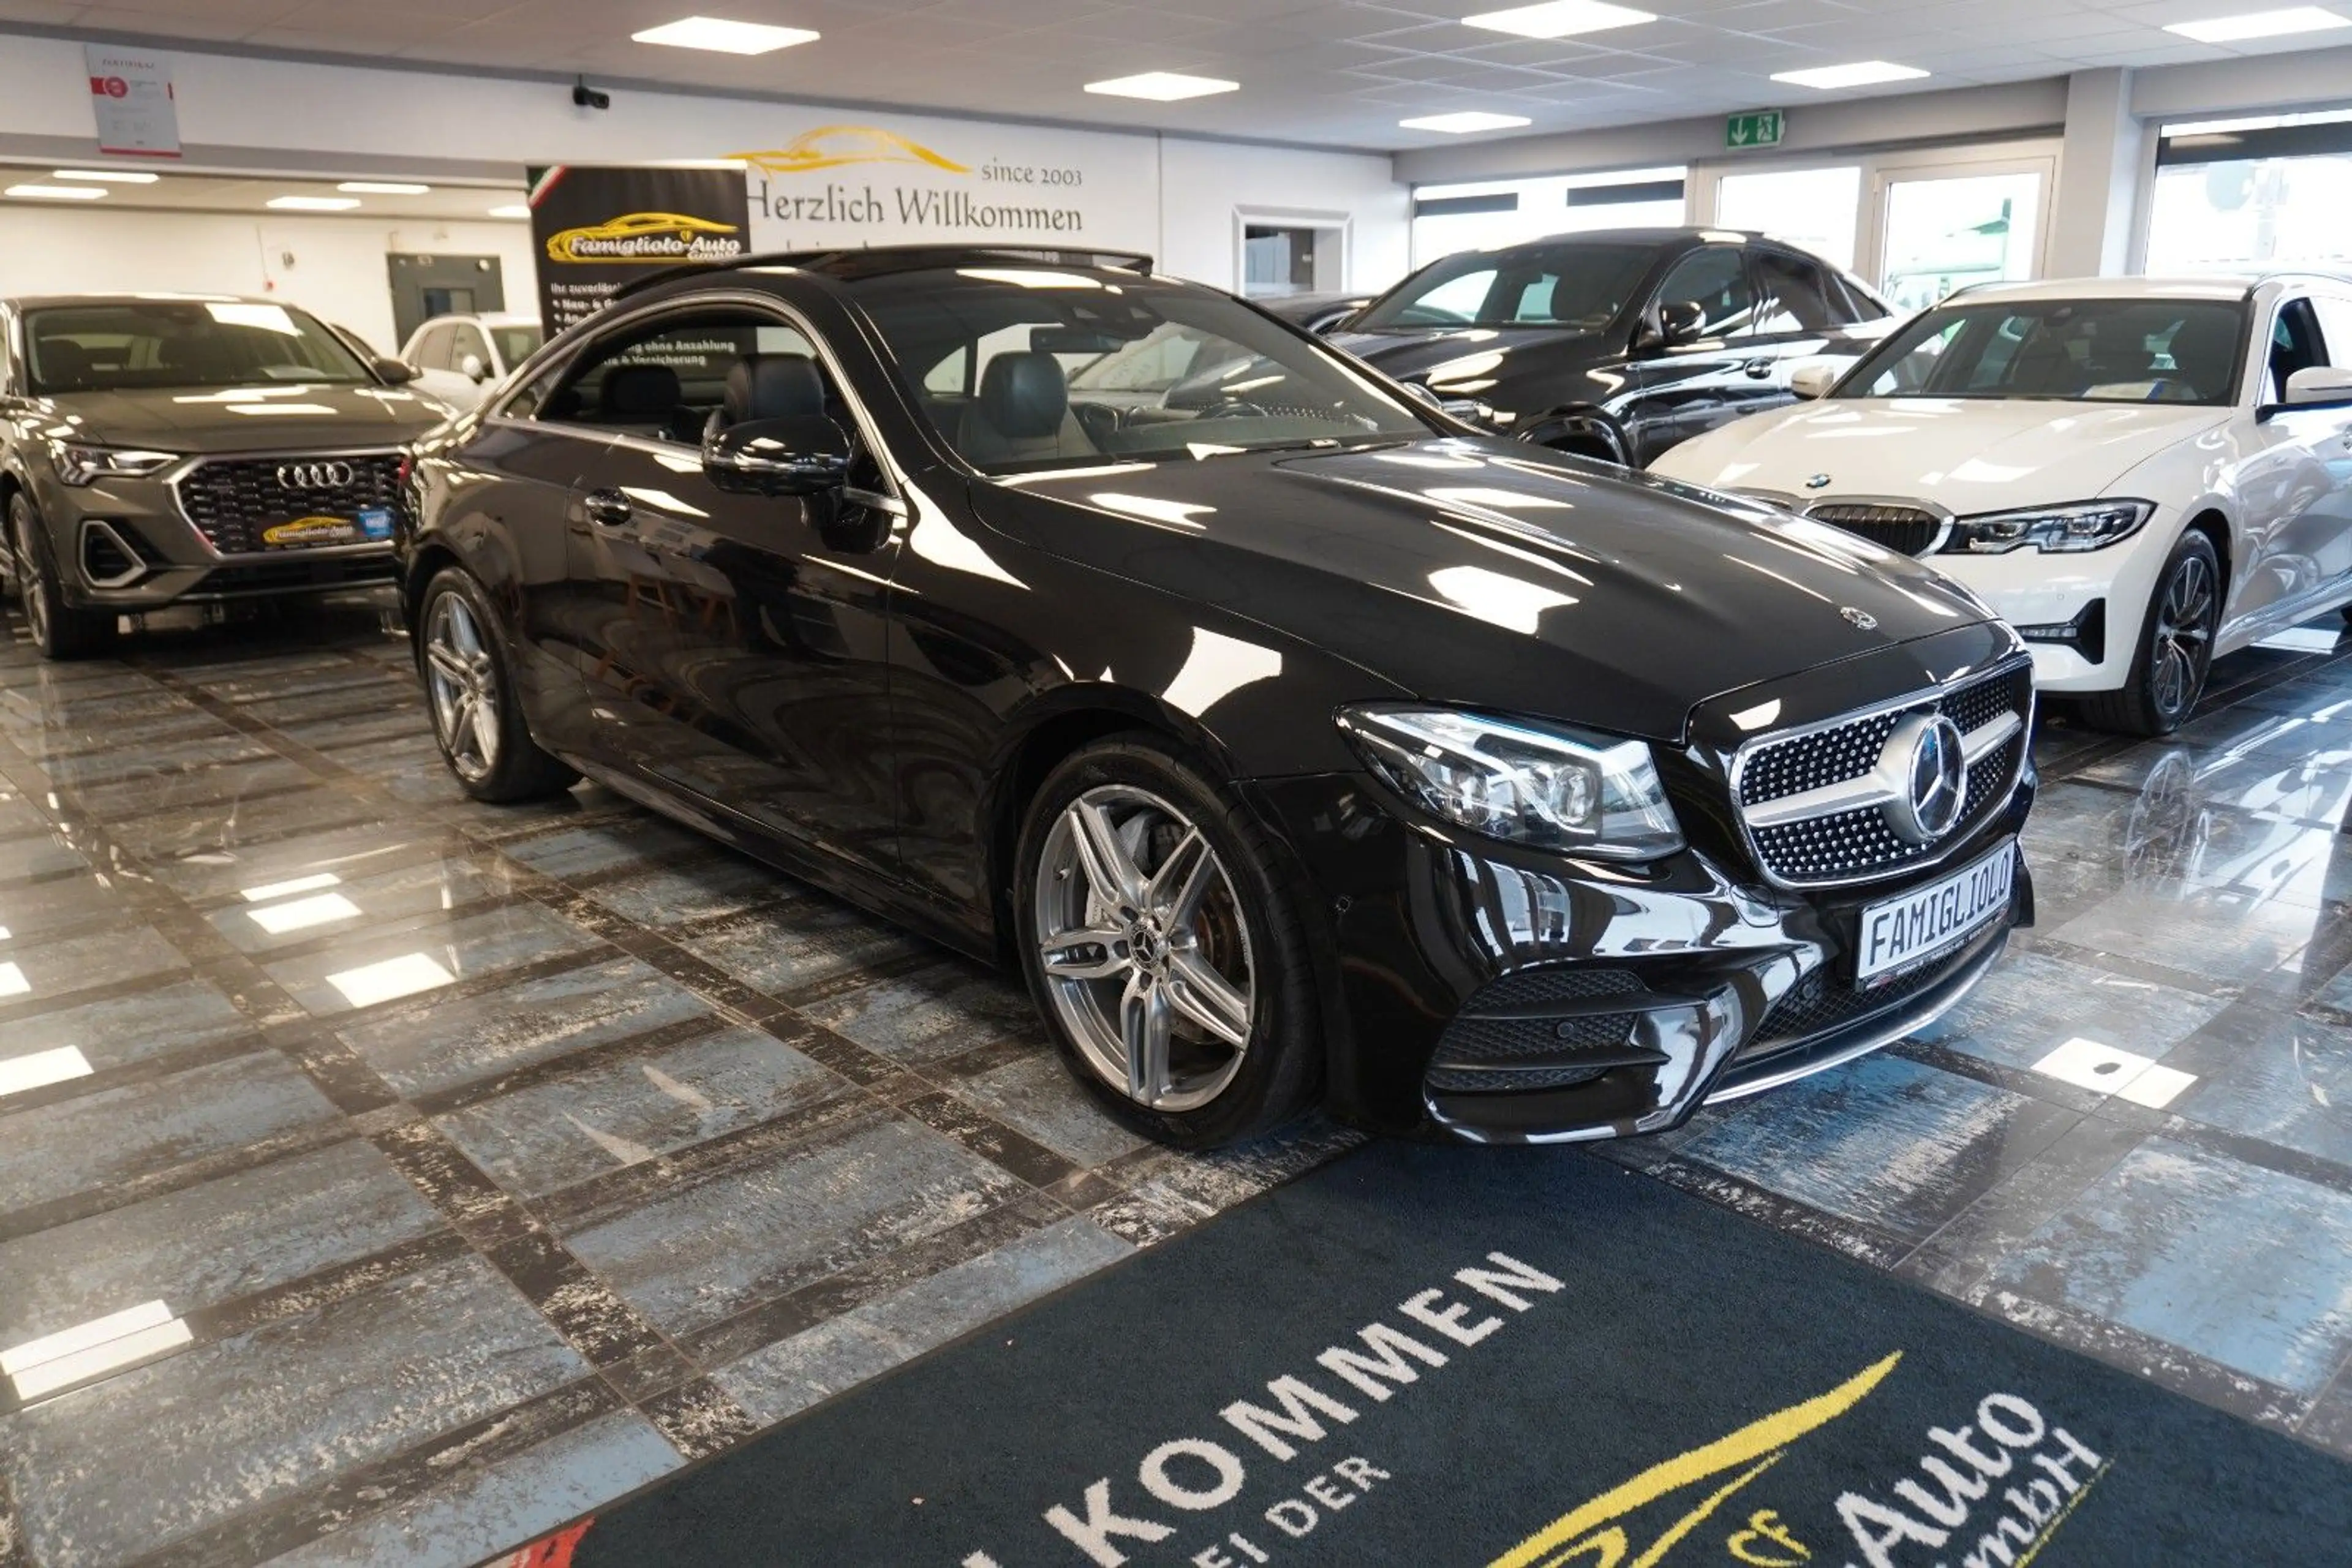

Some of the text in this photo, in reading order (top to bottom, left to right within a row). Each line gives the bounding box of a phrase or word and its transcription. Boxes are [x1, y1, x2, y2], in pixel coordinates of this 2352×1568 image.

[981, 156, 1082, 186] since 2003
[748, 179, 1082, 231] Herzlich Willkommen
[631, 355, 707, 367] Versicherung
[675, 339, 736, 353] Anzahlung
[1869, 851, 2009, 967] FAMIGLIOLO
[1265, 1457, 1390, 1537] DER
[1936, 1427, 2101, 1568] mbH
